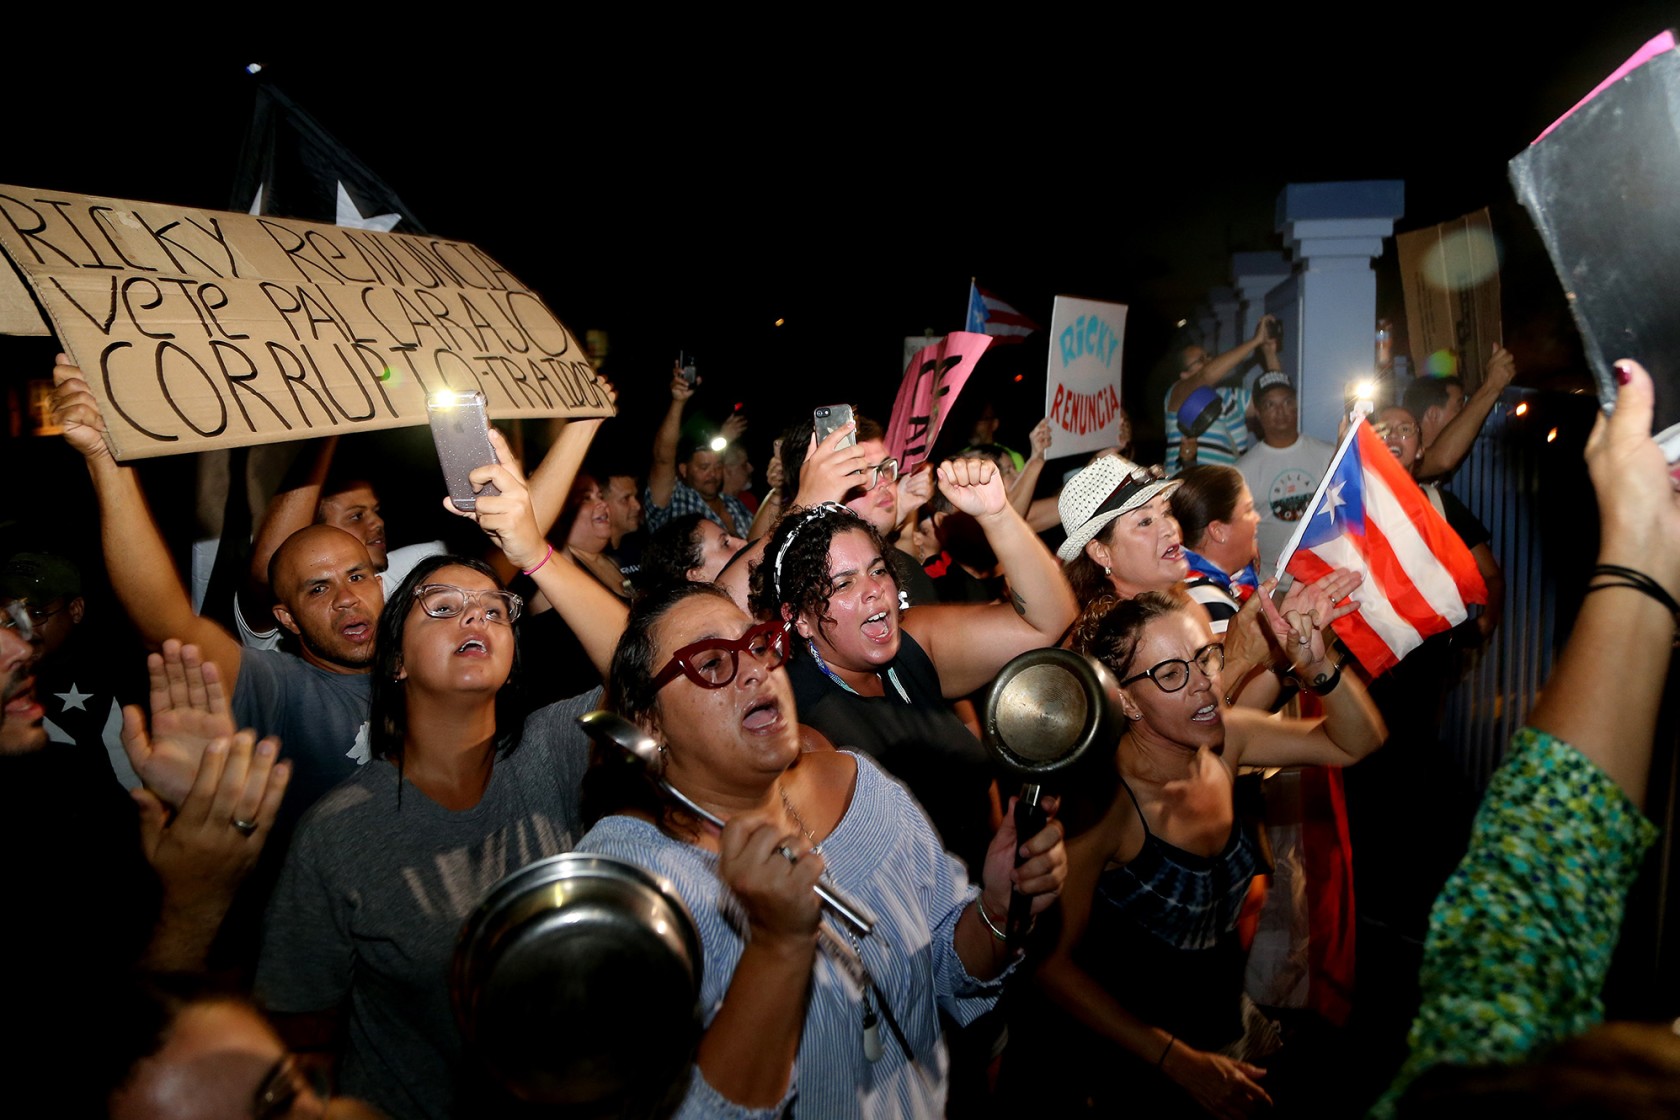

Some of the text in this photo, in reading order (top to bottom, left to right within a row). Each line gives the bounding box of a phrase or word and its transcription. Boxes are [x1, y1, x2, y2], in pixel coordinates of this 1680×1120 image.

[0, 193, 240, 279] RICKY
[258, 282, 378, 343] PAL
[360, 286, 568, 358] CARAJO
